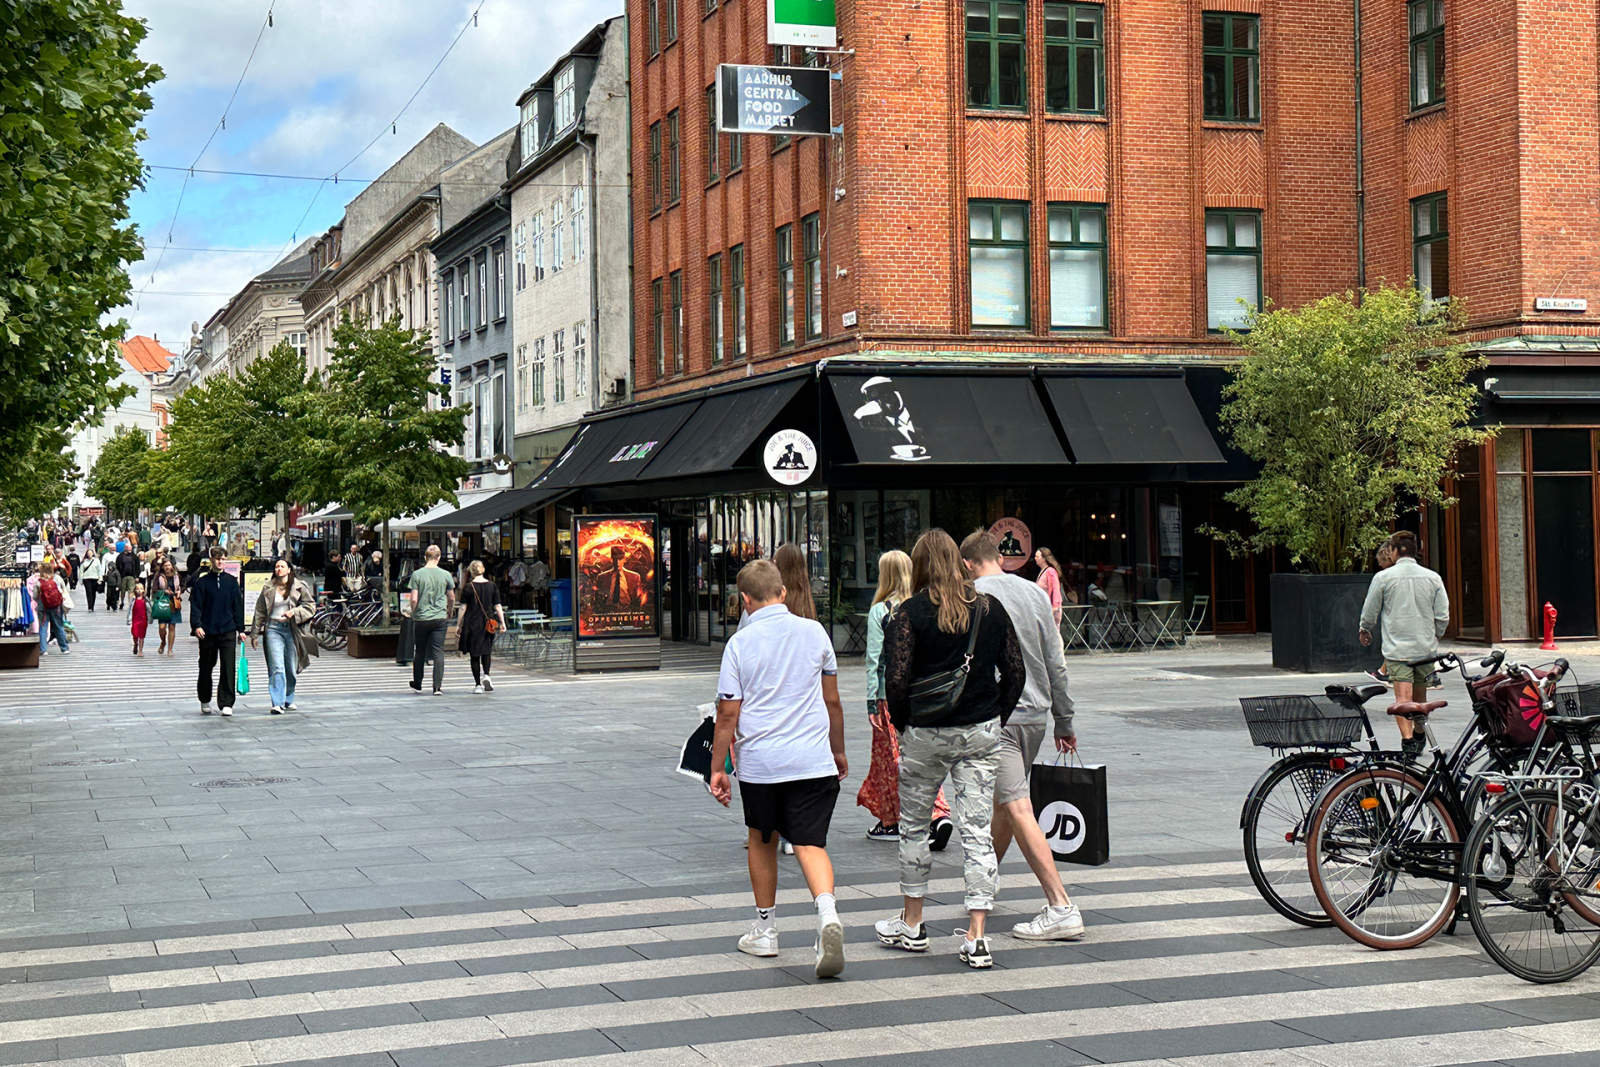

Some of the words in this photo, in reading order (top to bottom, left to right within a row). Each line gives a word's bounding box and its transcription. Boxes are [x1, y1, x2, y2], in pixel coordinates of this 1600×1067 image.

[744, 73, 793, 86] AARHUS
[744, 86, 800, 101] CENTRAL
[744, 100, 782, 113] FOOD
[744, 113, 796, 127] MARKET
[768, 438, 779, 452] JOE
[783, 432, 797, 440] THE
[797, 435, 813, 452] JUICE
[588, 615, 650, 623] OPPENHEIMER
[1045, 813, 1081, 841] JD
